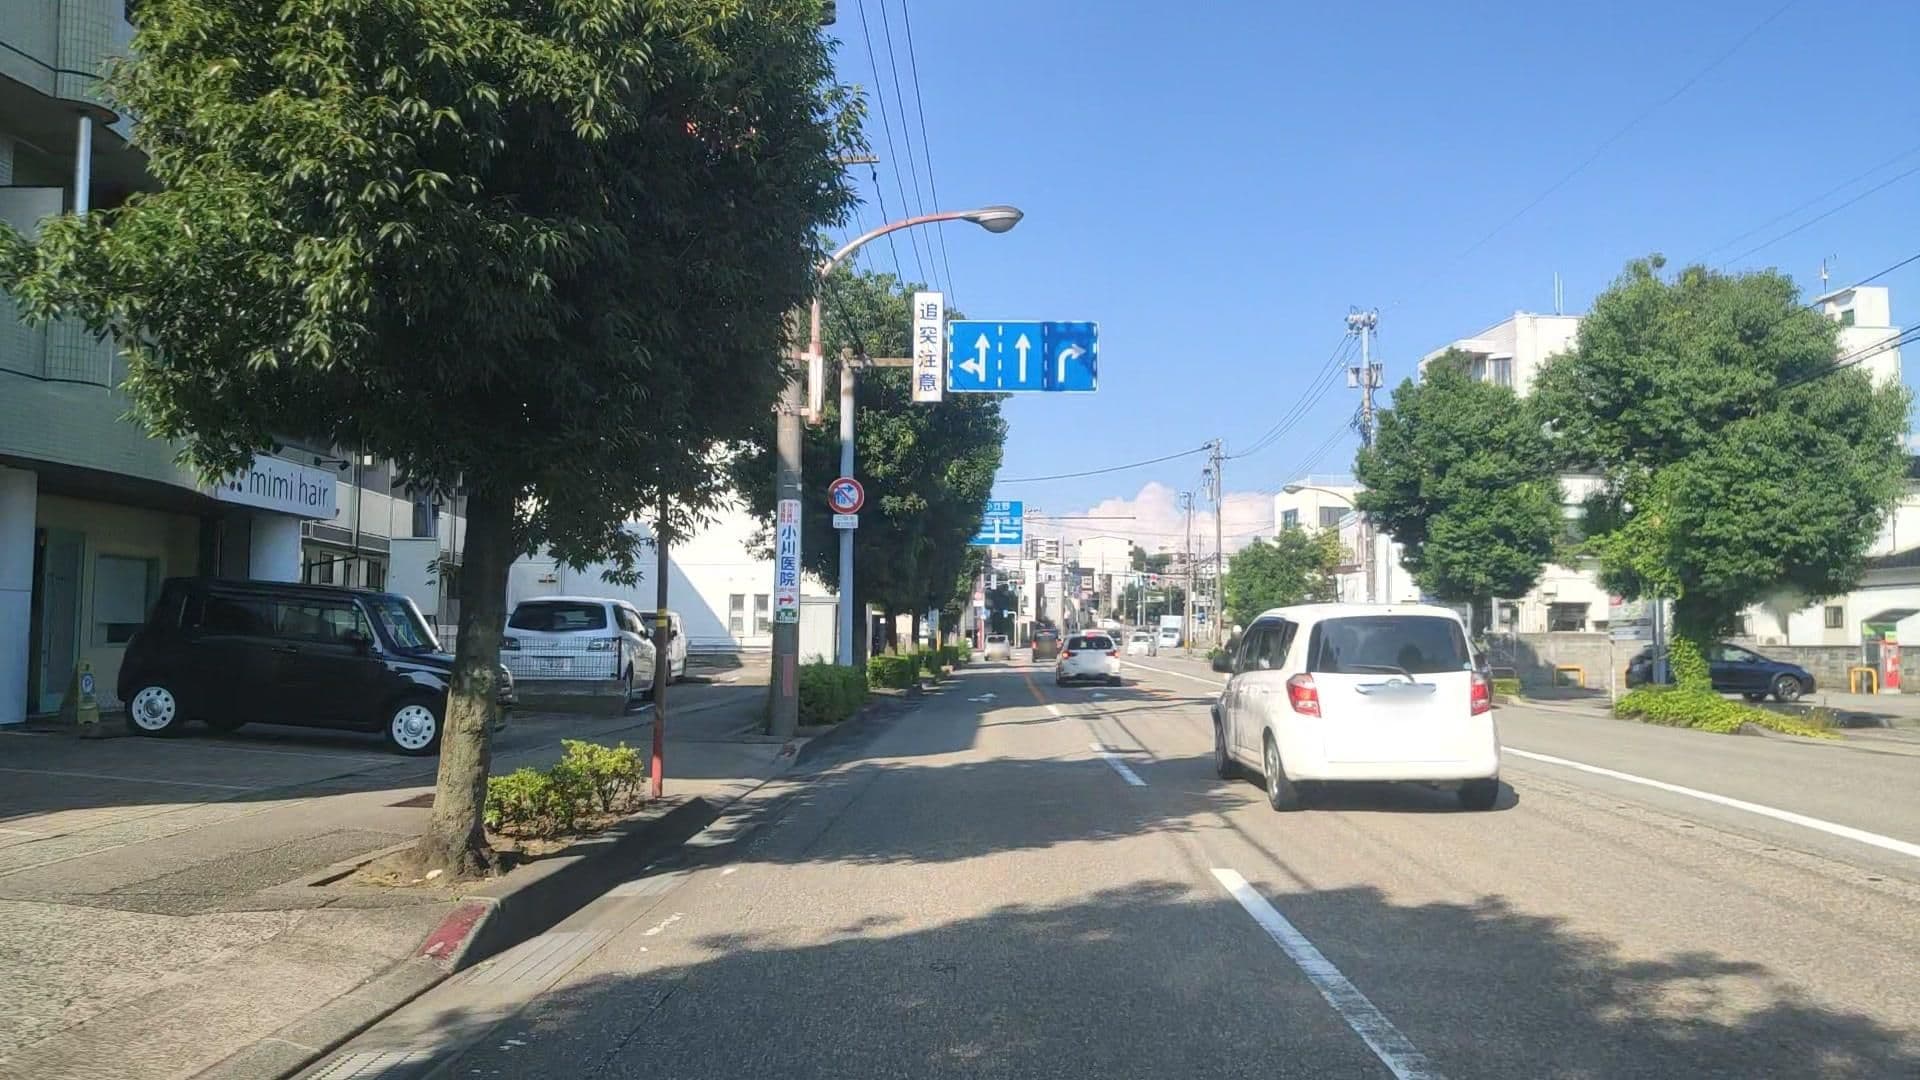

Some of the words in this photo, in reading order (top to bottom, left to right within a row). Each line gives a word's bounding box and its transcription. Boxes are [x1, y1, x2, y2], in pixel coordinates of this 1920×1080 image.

[918, 303, 938, 391] 追突注意
[249, 467, 294, 501] mimi
[779, 525, 796, 586] 小川医院
